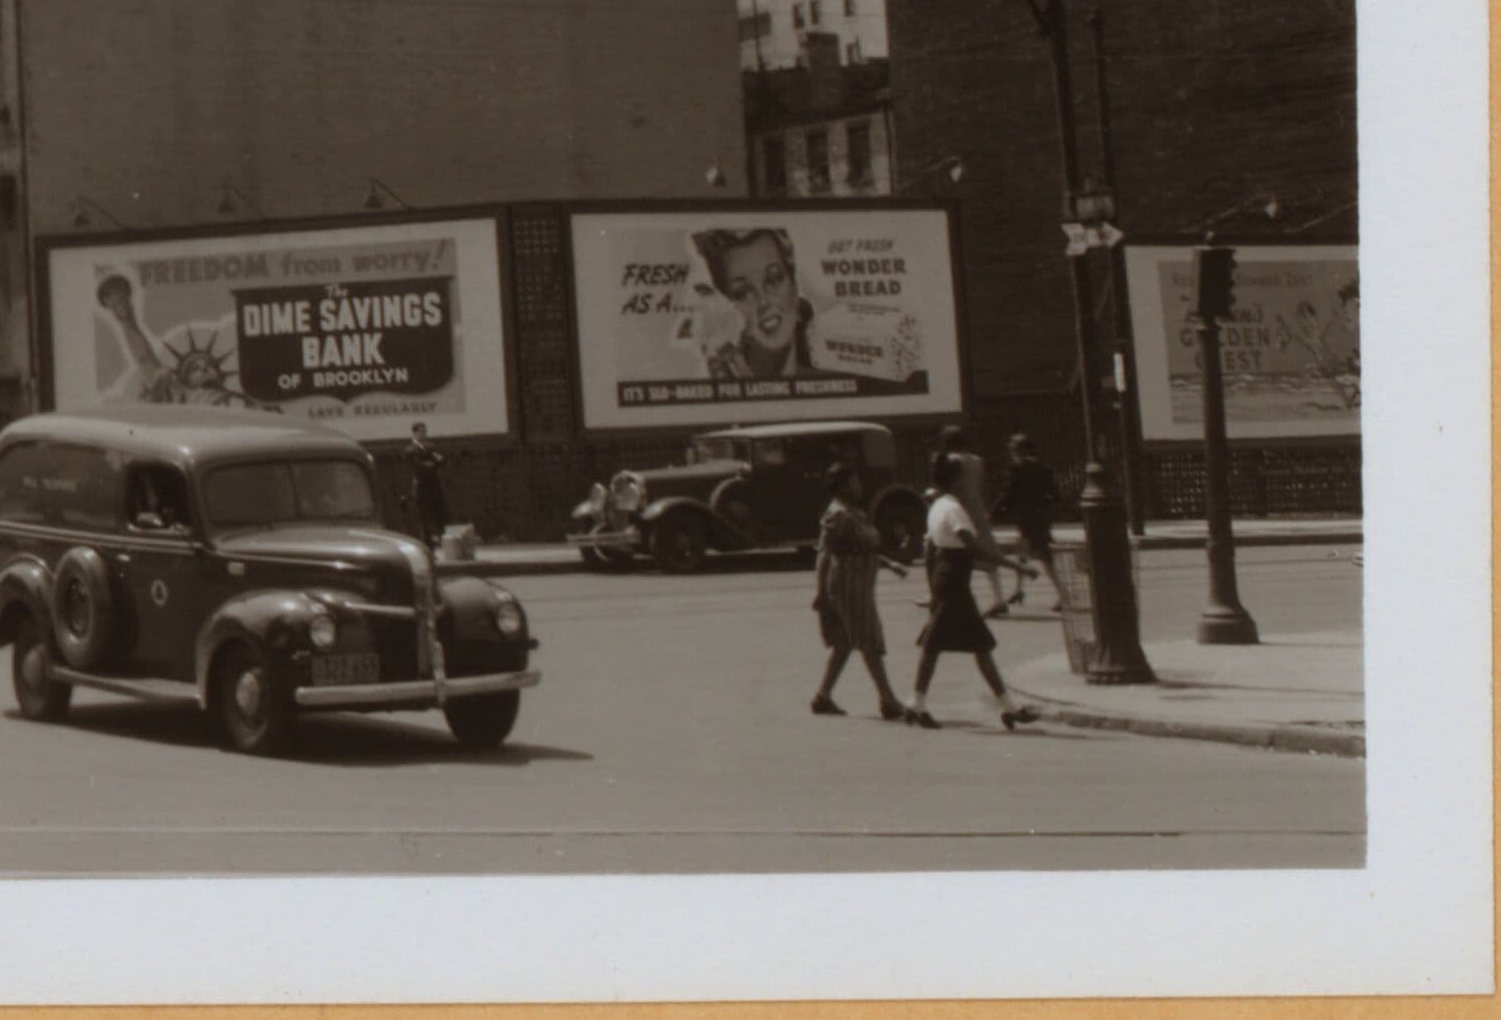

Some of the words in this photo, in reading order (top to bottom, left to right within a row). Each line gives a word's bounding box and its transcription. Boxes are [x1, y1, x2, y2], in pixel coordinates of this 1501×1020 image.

[139, 253, 270, 285] FREEDOM
[282, 252, 341, 277] from
[353, 239, 448, 273] worry!
[820, 258, 907, 275] WONDER
[621, 262, 690, 286] FRESH
[325, 284, 349, 298] The
[834, 280, 902, 297] BREAD
[243, 300, 312, 337] DIME
[319, 291, 443, 332] SAVINGS
[621, 292, 653, 315] AS
[301, 332, 386, 369] BANK
[277, 373, 301, 390] OF
[313, 367, 409, 389] BROOKLYN
[718, 382, 741, 398] FOR
[745, 380, 789, 397] LASTING
